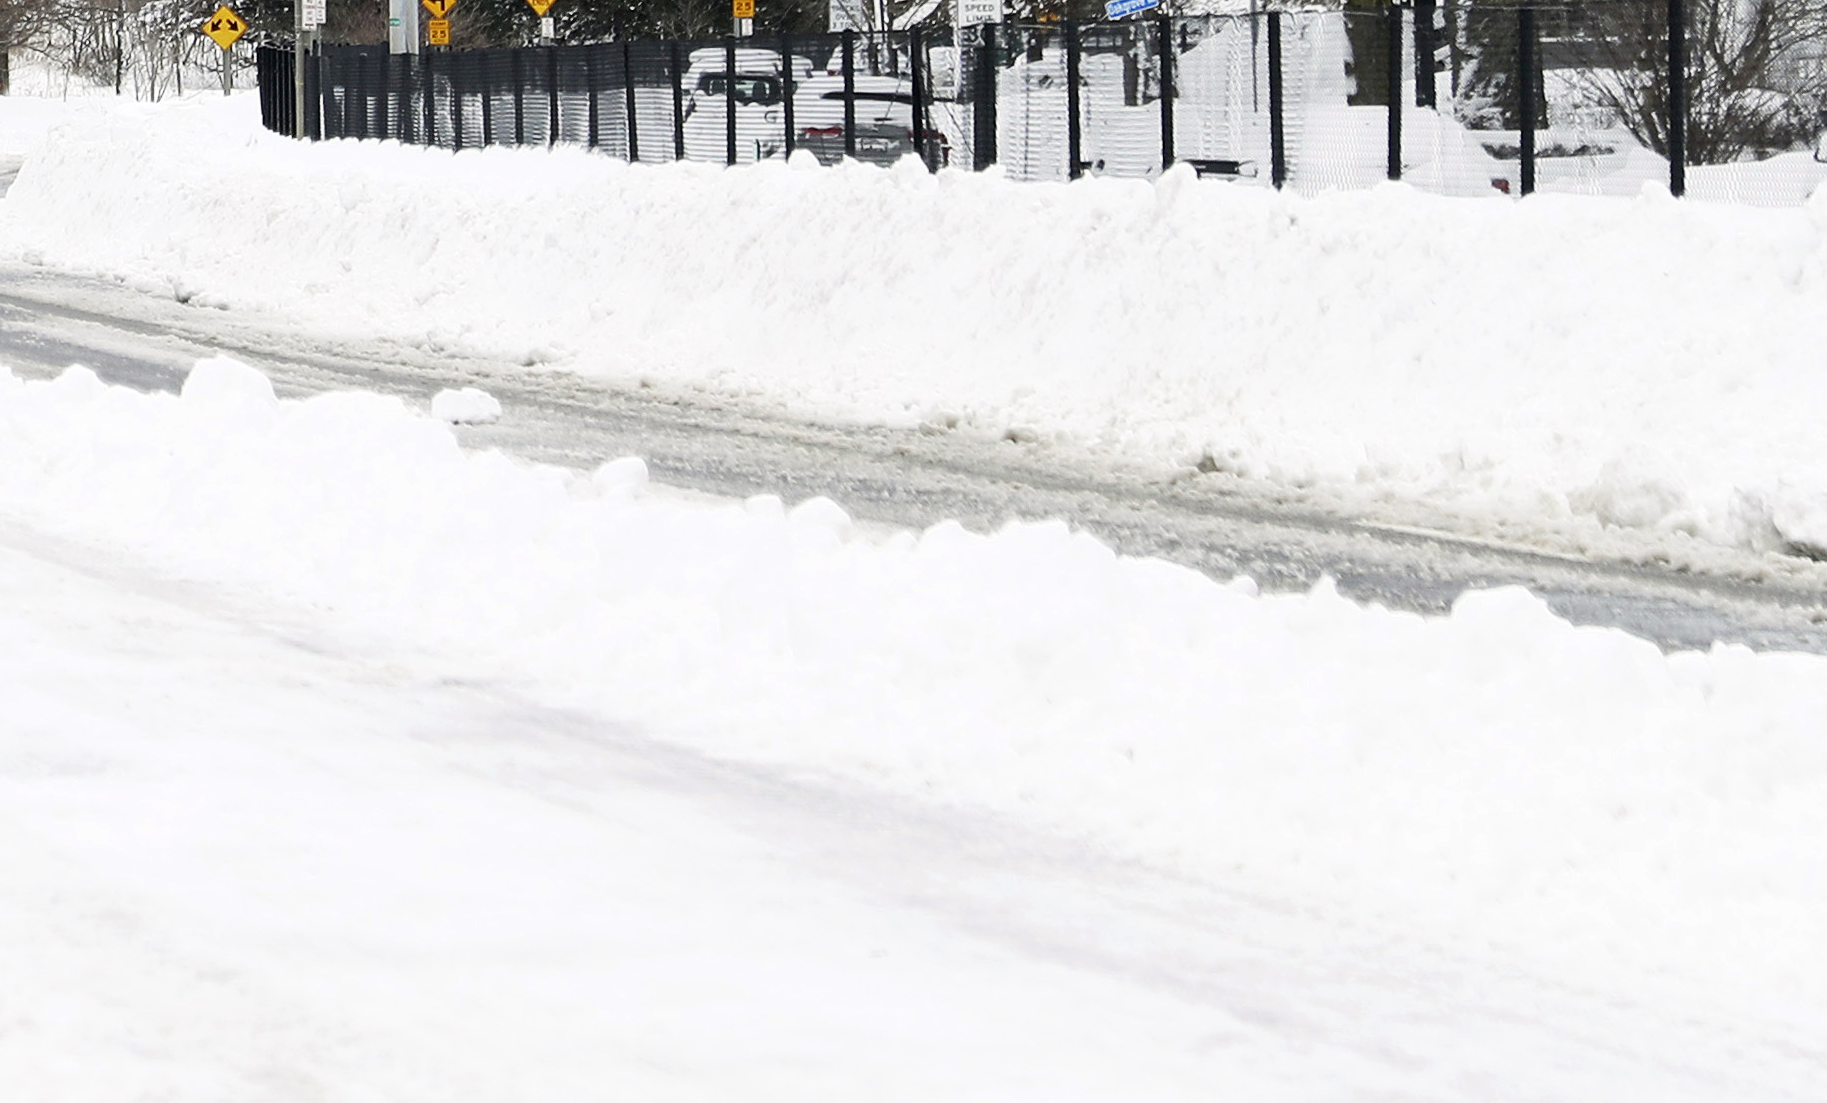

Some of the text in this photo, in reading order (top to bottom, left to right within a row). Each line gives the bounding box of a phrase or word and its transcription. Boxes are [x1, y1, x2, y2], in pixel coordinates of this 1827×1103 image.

[736, 2, 752, 11] 25
[965, 4, 995, 12] SPEED
[431, 30, 447, 38] 25
